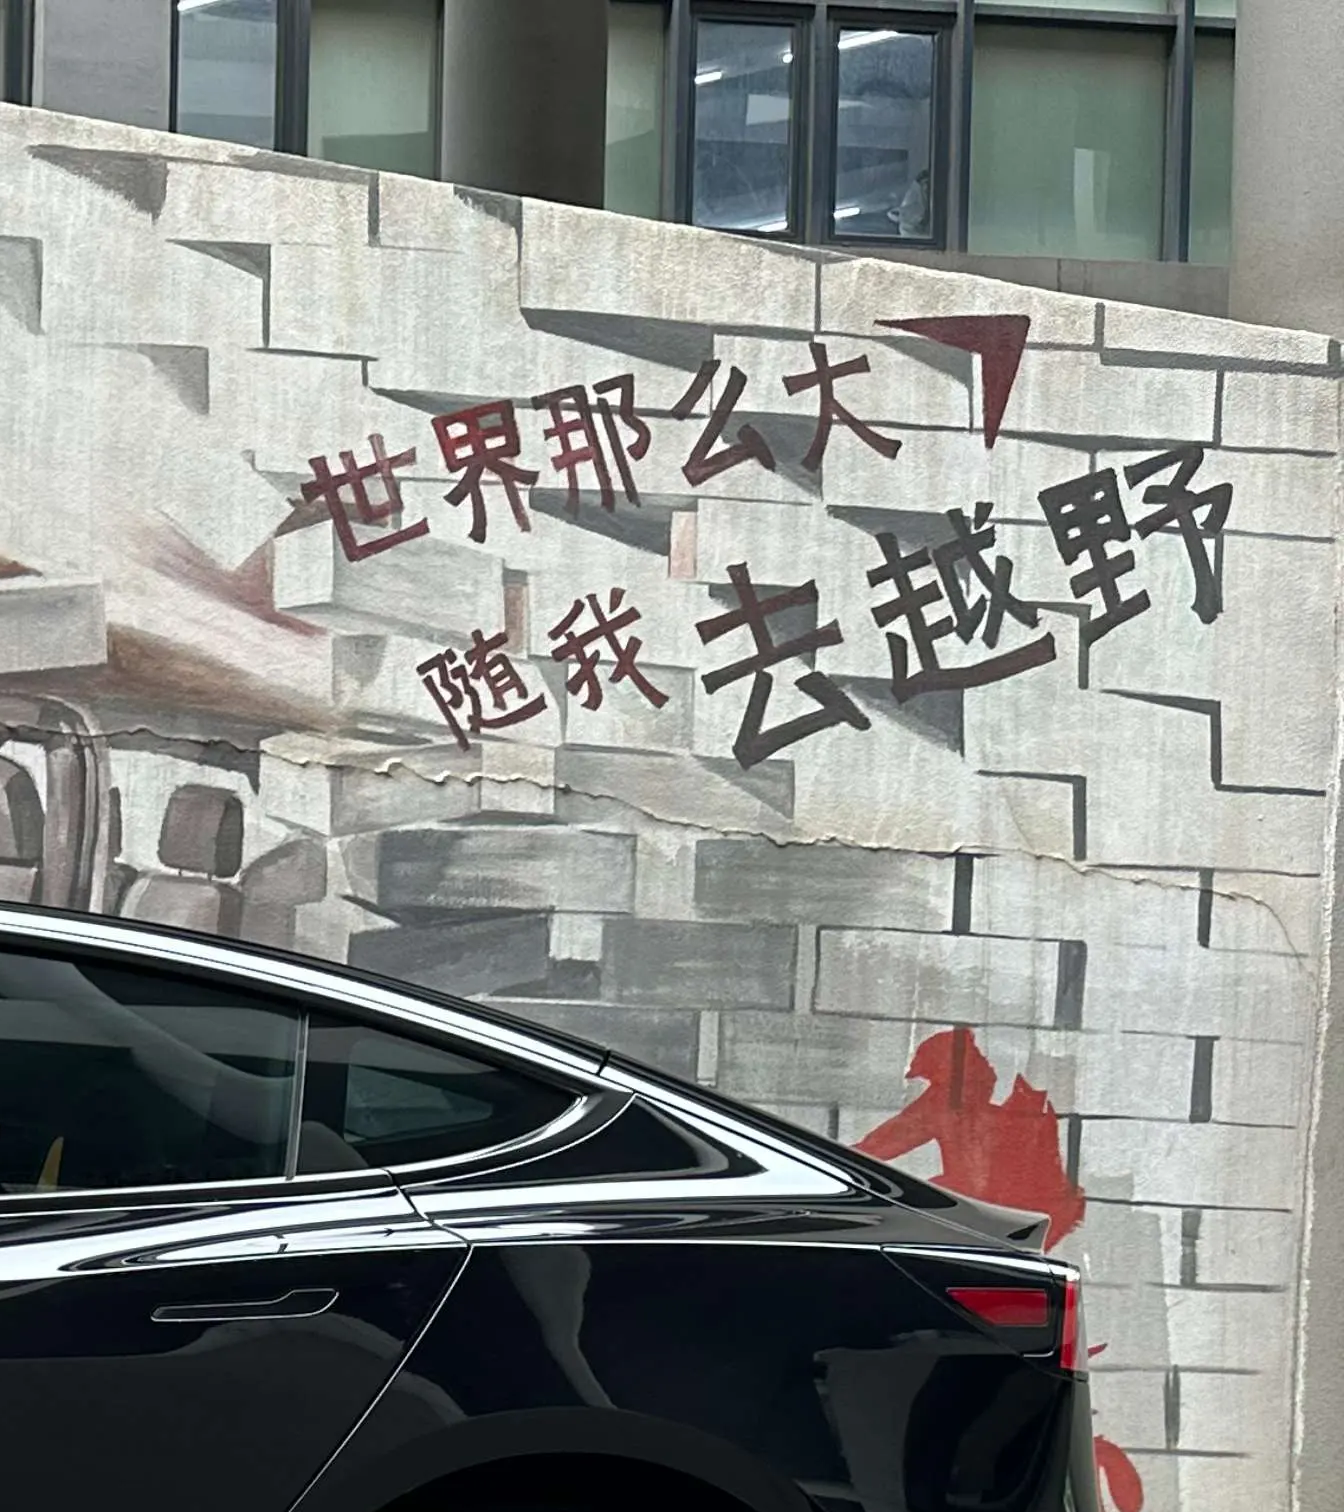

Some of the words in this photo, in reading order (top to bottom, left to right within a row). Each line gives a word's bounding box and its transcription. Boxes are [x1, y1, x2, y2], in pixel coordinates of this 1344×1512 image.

[300, 341, 902, 562] 世界那么大
[417, 446, 1233, 770] 随我去越野
